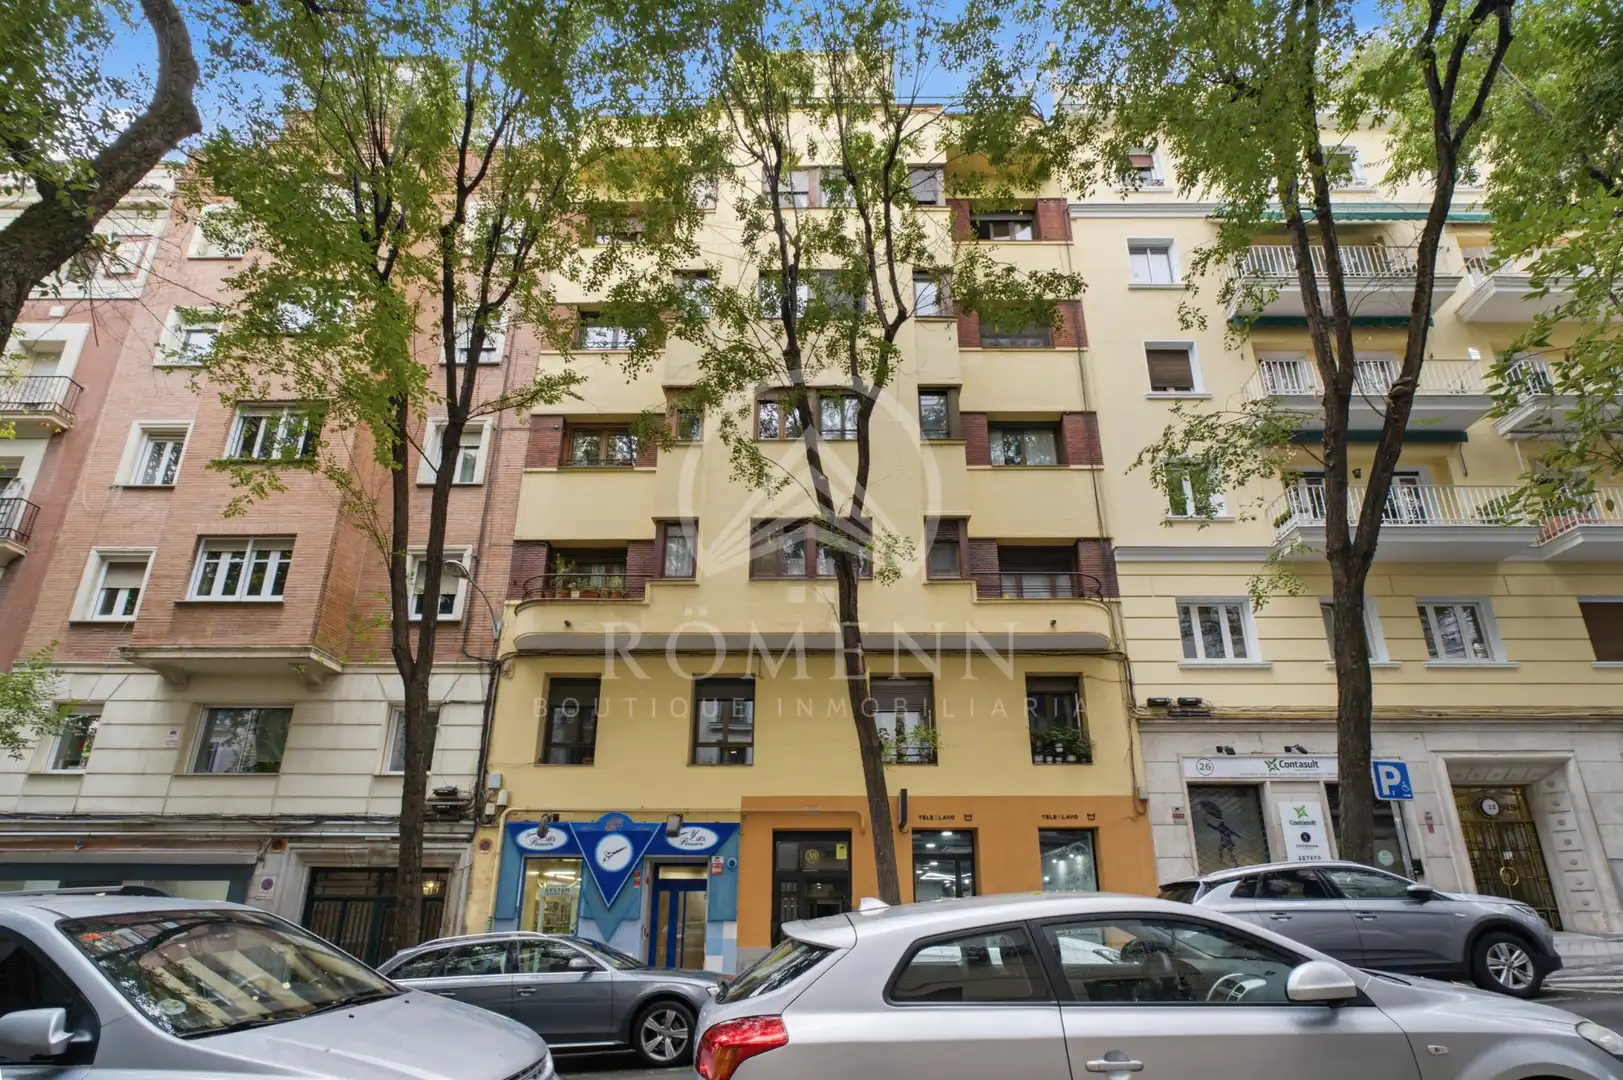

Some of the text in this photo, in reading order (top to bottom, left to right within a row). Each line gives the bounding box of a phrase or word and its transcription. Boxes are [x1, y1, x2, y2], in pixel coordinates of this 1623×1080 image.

[1199, 762, 1211, 771] 26
[1279, 759, 1320, 769] Contasult
[1378, 764, 1401, 795] P
